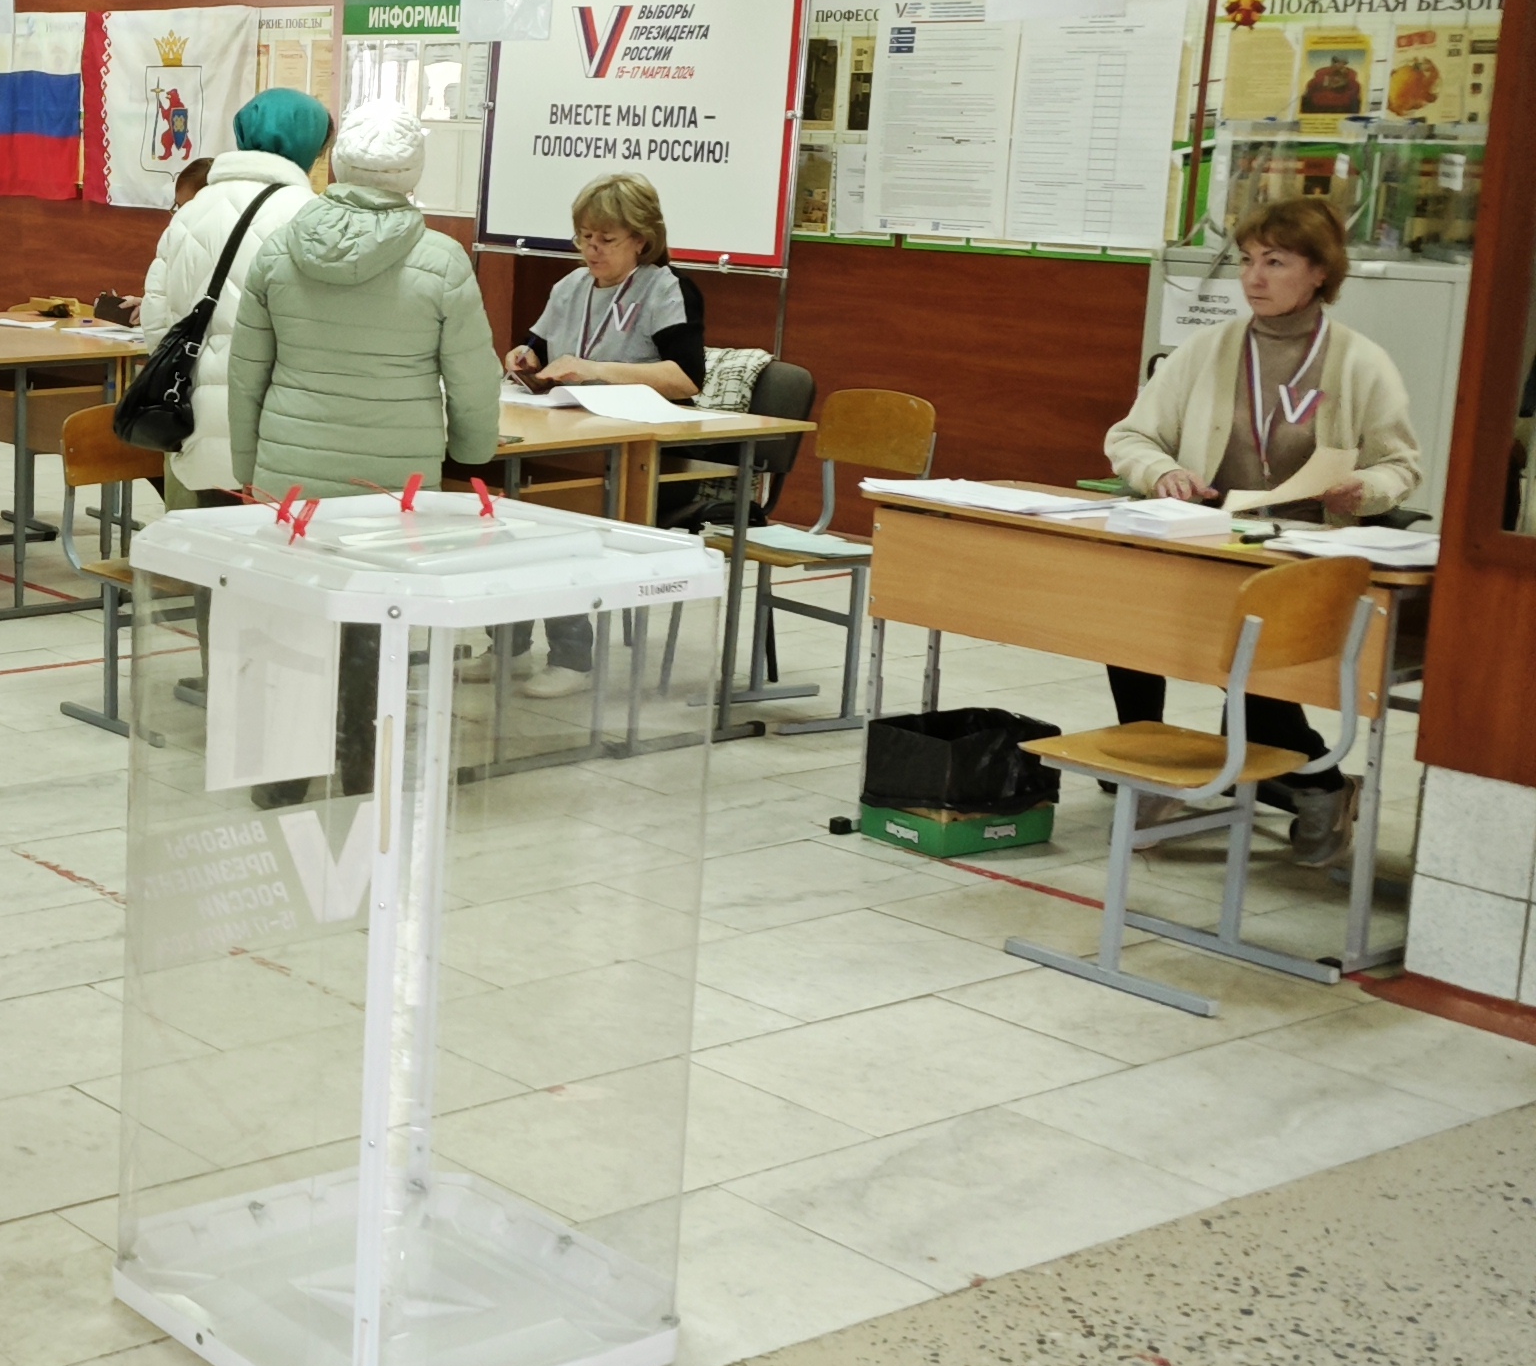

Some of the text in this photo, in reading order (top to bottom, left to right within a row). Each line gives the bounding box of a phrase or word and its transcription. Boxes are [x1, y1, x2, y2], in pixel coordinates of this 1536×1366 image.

[368, 5, 460, 31] ИНФОРМАЦ
[637, 4, 696, 20] ВЫБОРЫ
[285, 17, 323, 29] ПОБЕДЫ
[629, 24, 710, 42] ПРЕЗИДЕНТА
[621, 46, 673, 61] РОССИИ
[640, 66, 670, 79] МАРТА
[671, 66, 695, 79] 2024
[549, 103, 612, 126] ВМЕСТЕ
[616, 105, 647, 127] МЫ
[651, 105, 698, 128] СИЛА
[533, 135, 730, 164] ГОЛОСУЕМ ЗА РОССИЮ!
